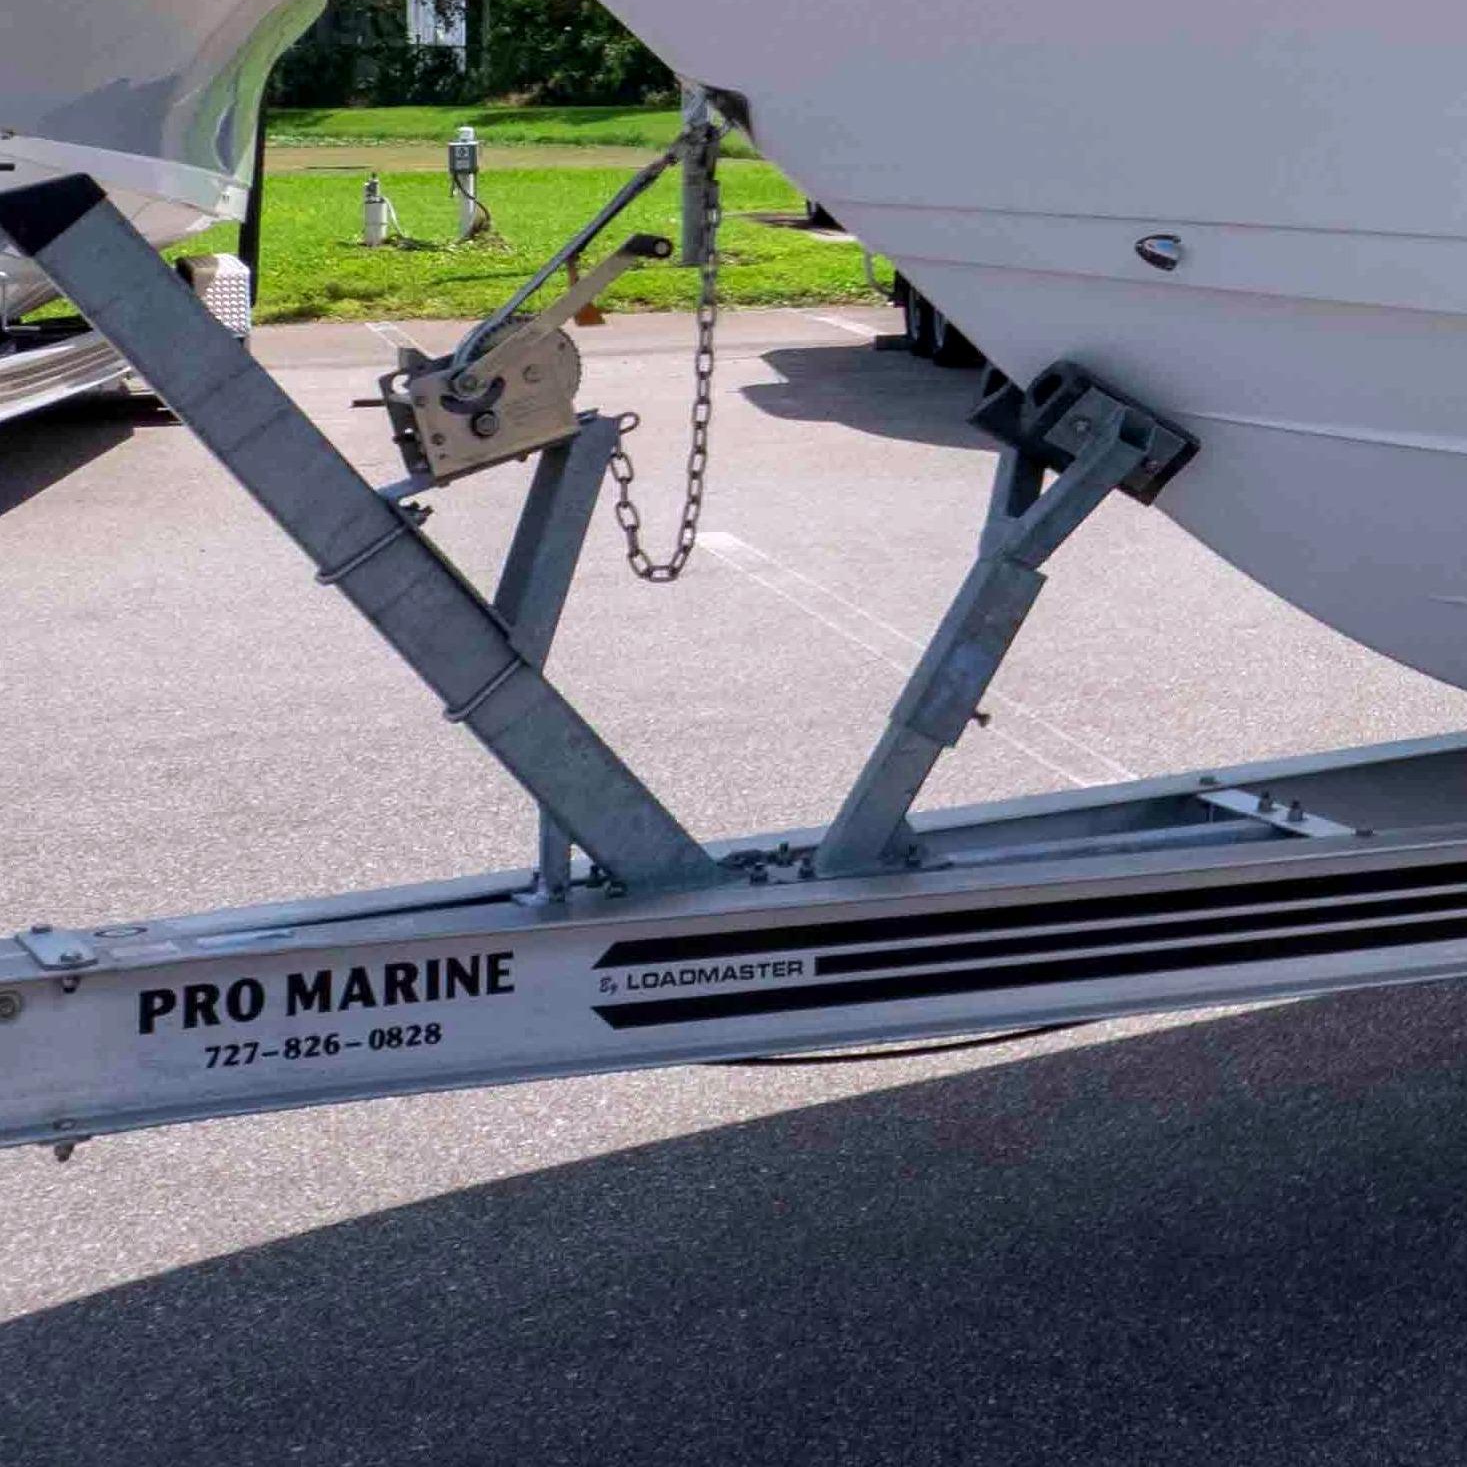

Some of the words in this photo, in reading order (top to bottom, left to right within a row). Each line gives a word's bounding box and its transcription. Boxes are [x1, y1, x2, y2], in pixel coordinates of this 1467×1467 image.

[138, 977, 266, 1034] PRO
[285, 951, 515, 1017] MARINE
[626, 960, 804, 990] LOADMASTER
[204, 1022, 443, 1069] 727-826-0828
